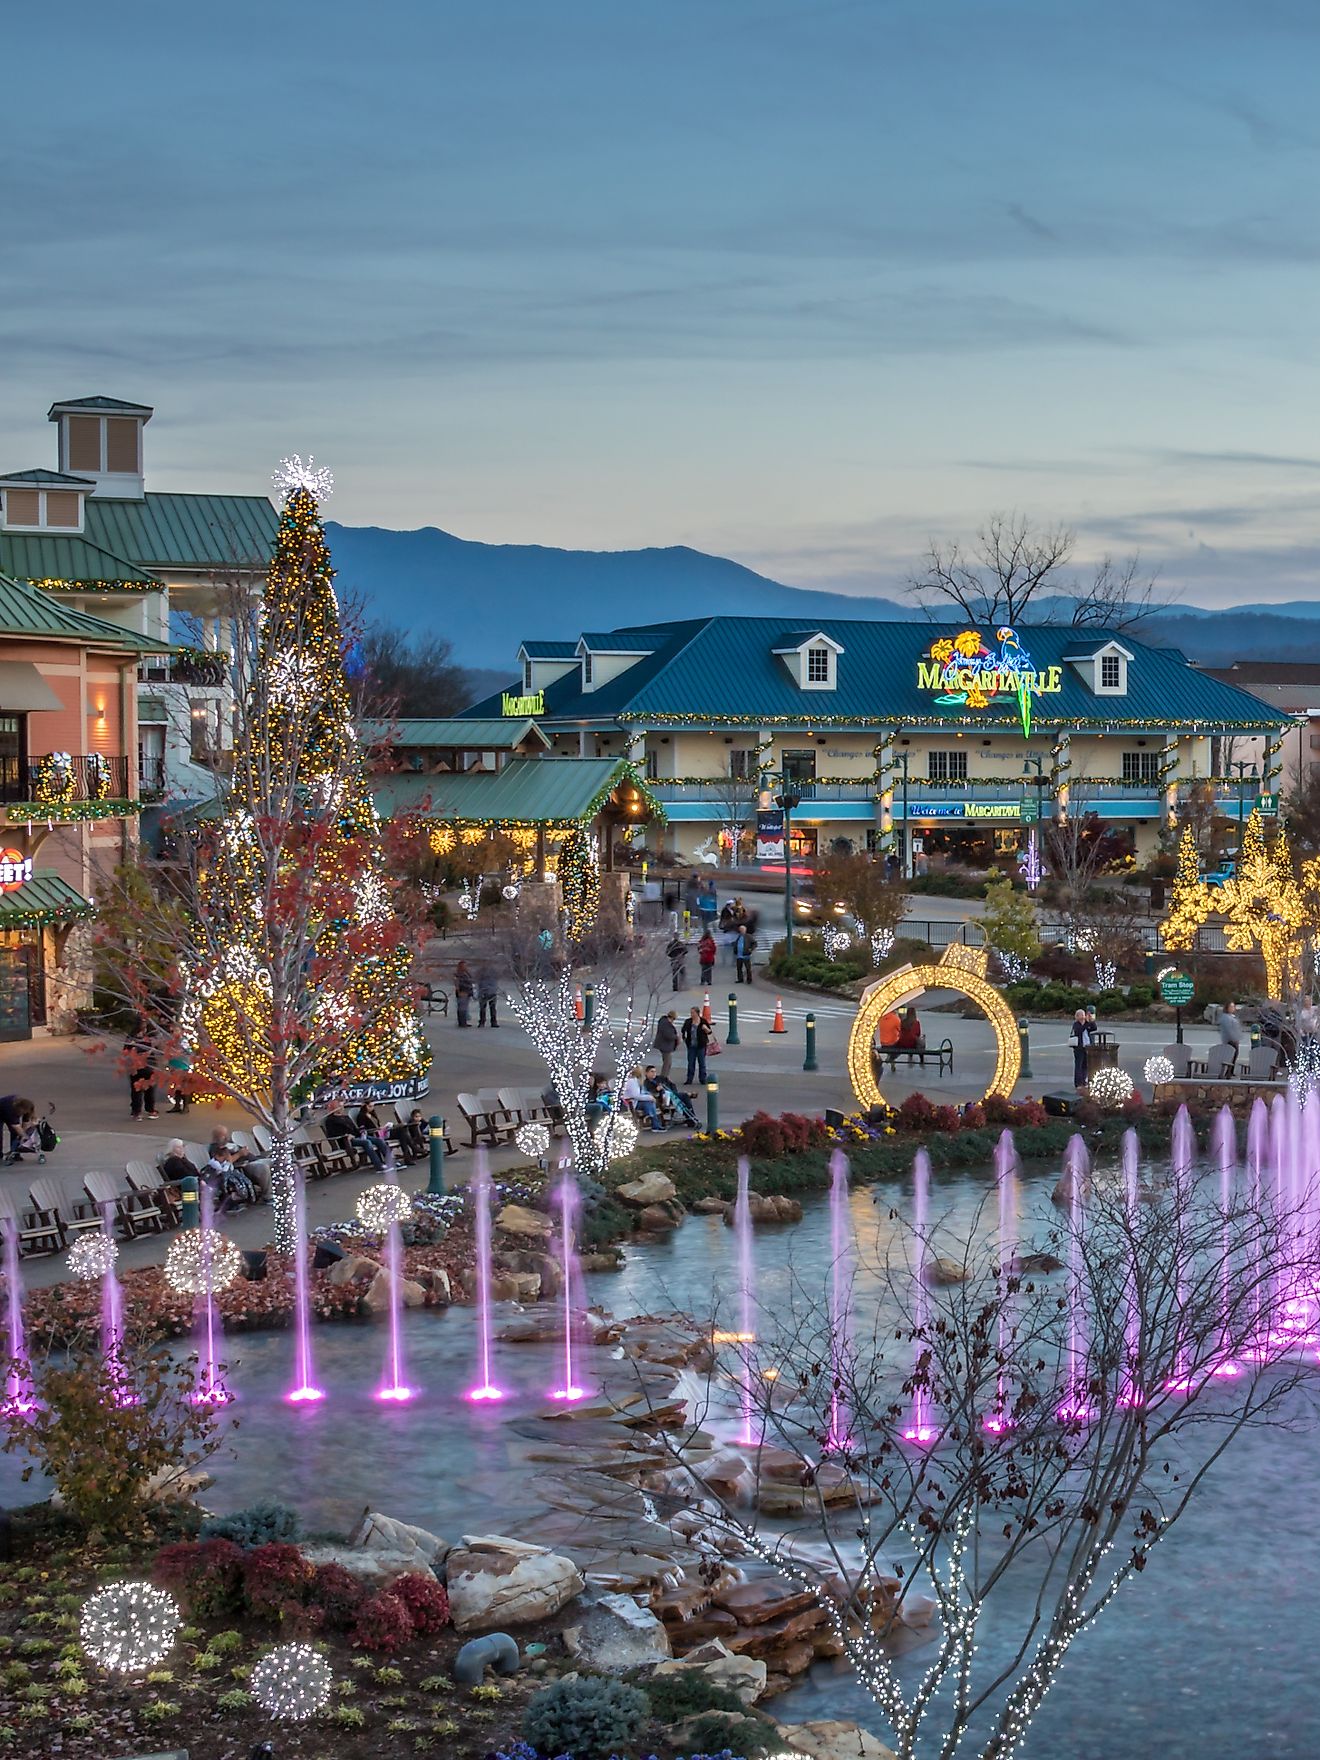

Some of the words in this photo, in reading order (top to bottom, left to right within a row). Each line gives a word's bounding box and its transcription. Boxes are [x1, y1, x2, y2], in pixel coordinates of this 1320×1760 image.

[917, 662, 1063, 693] MARGARITAVILLE
[911, 803, 950, 817] Welcome
[964, 803, 1021, 817] MARGARITAVIL
[388, 1083, 408, 1098] JOY
